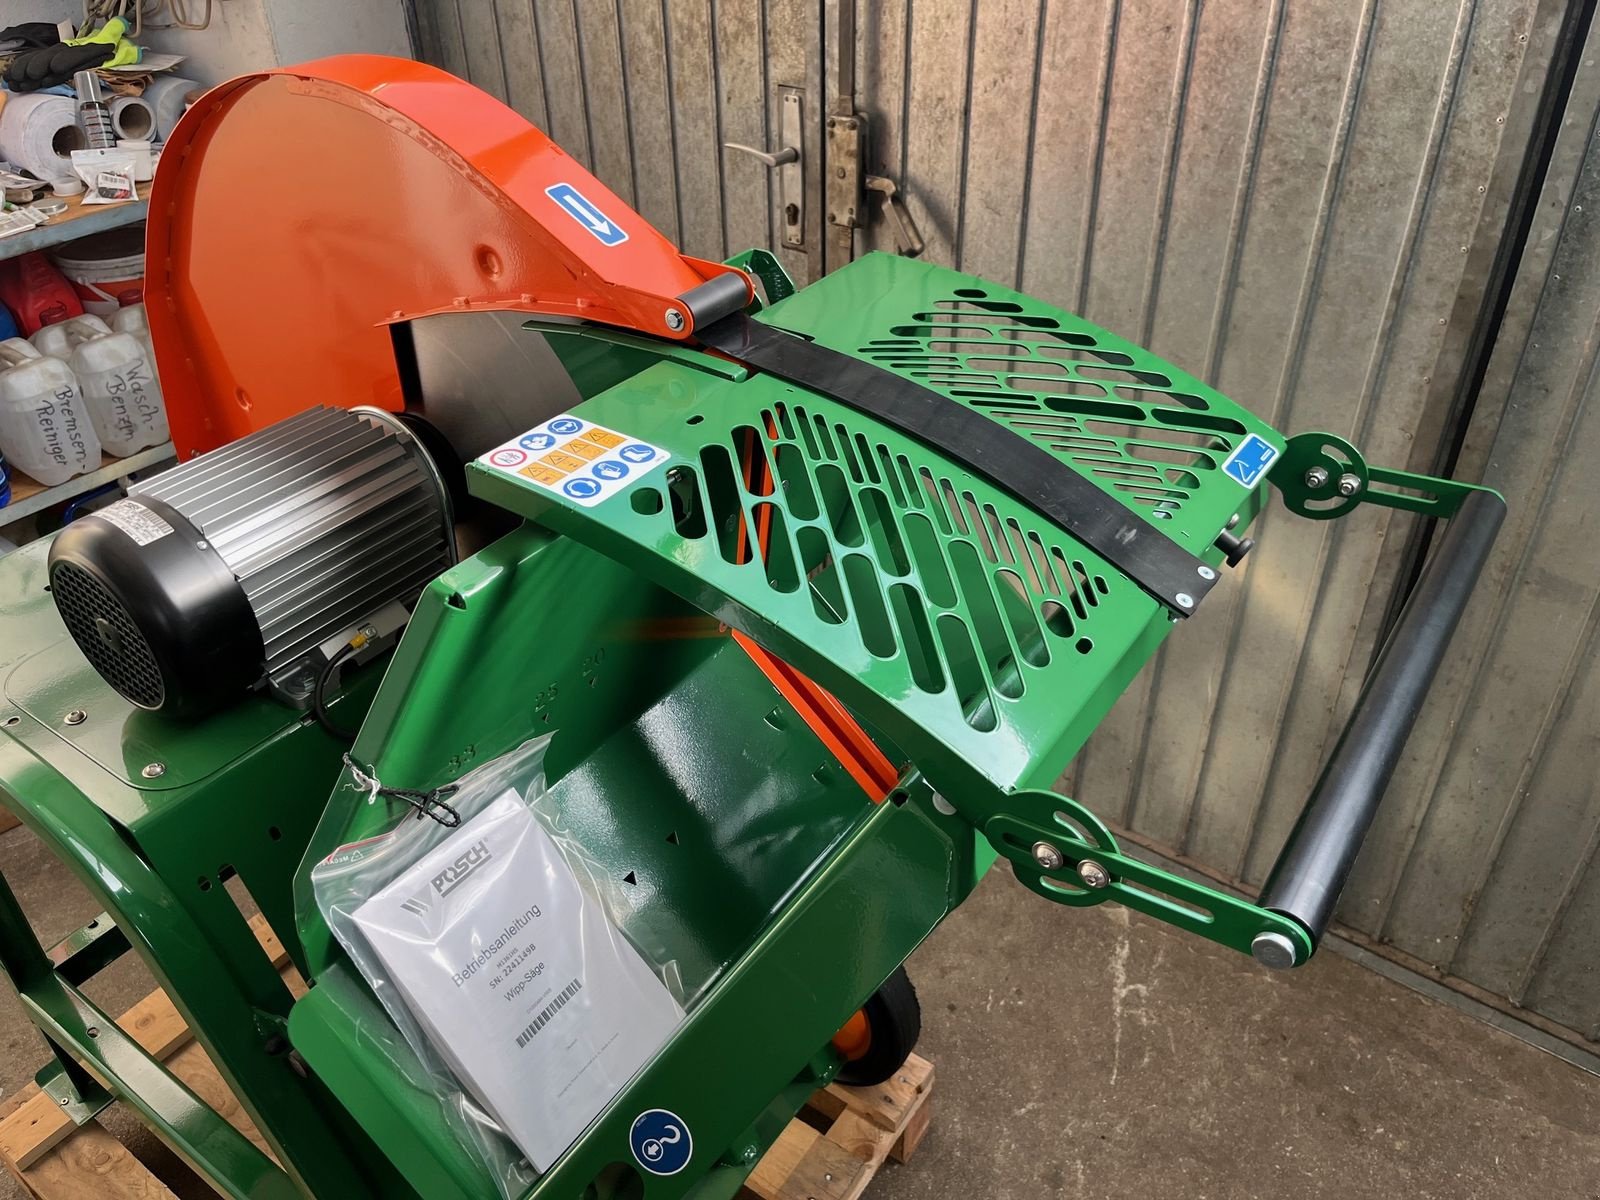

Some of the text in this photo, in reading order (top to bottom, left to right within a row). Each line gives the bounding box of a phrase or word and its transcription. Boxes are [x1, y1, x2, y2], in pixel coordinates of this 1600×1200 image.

[54, 385, 87, 470] Bremsen-
[106, 374, 134, 442] Benzin
[126, 358, 159, 431] Wasch-
[36, 400, 68, 466] Reiniger
[451, 904, 541, 987] Betriebsanleitung
[489, 943, 537, 990] SN: 2241149B
[504, 961, 545, 1001] Wipp-Säge
